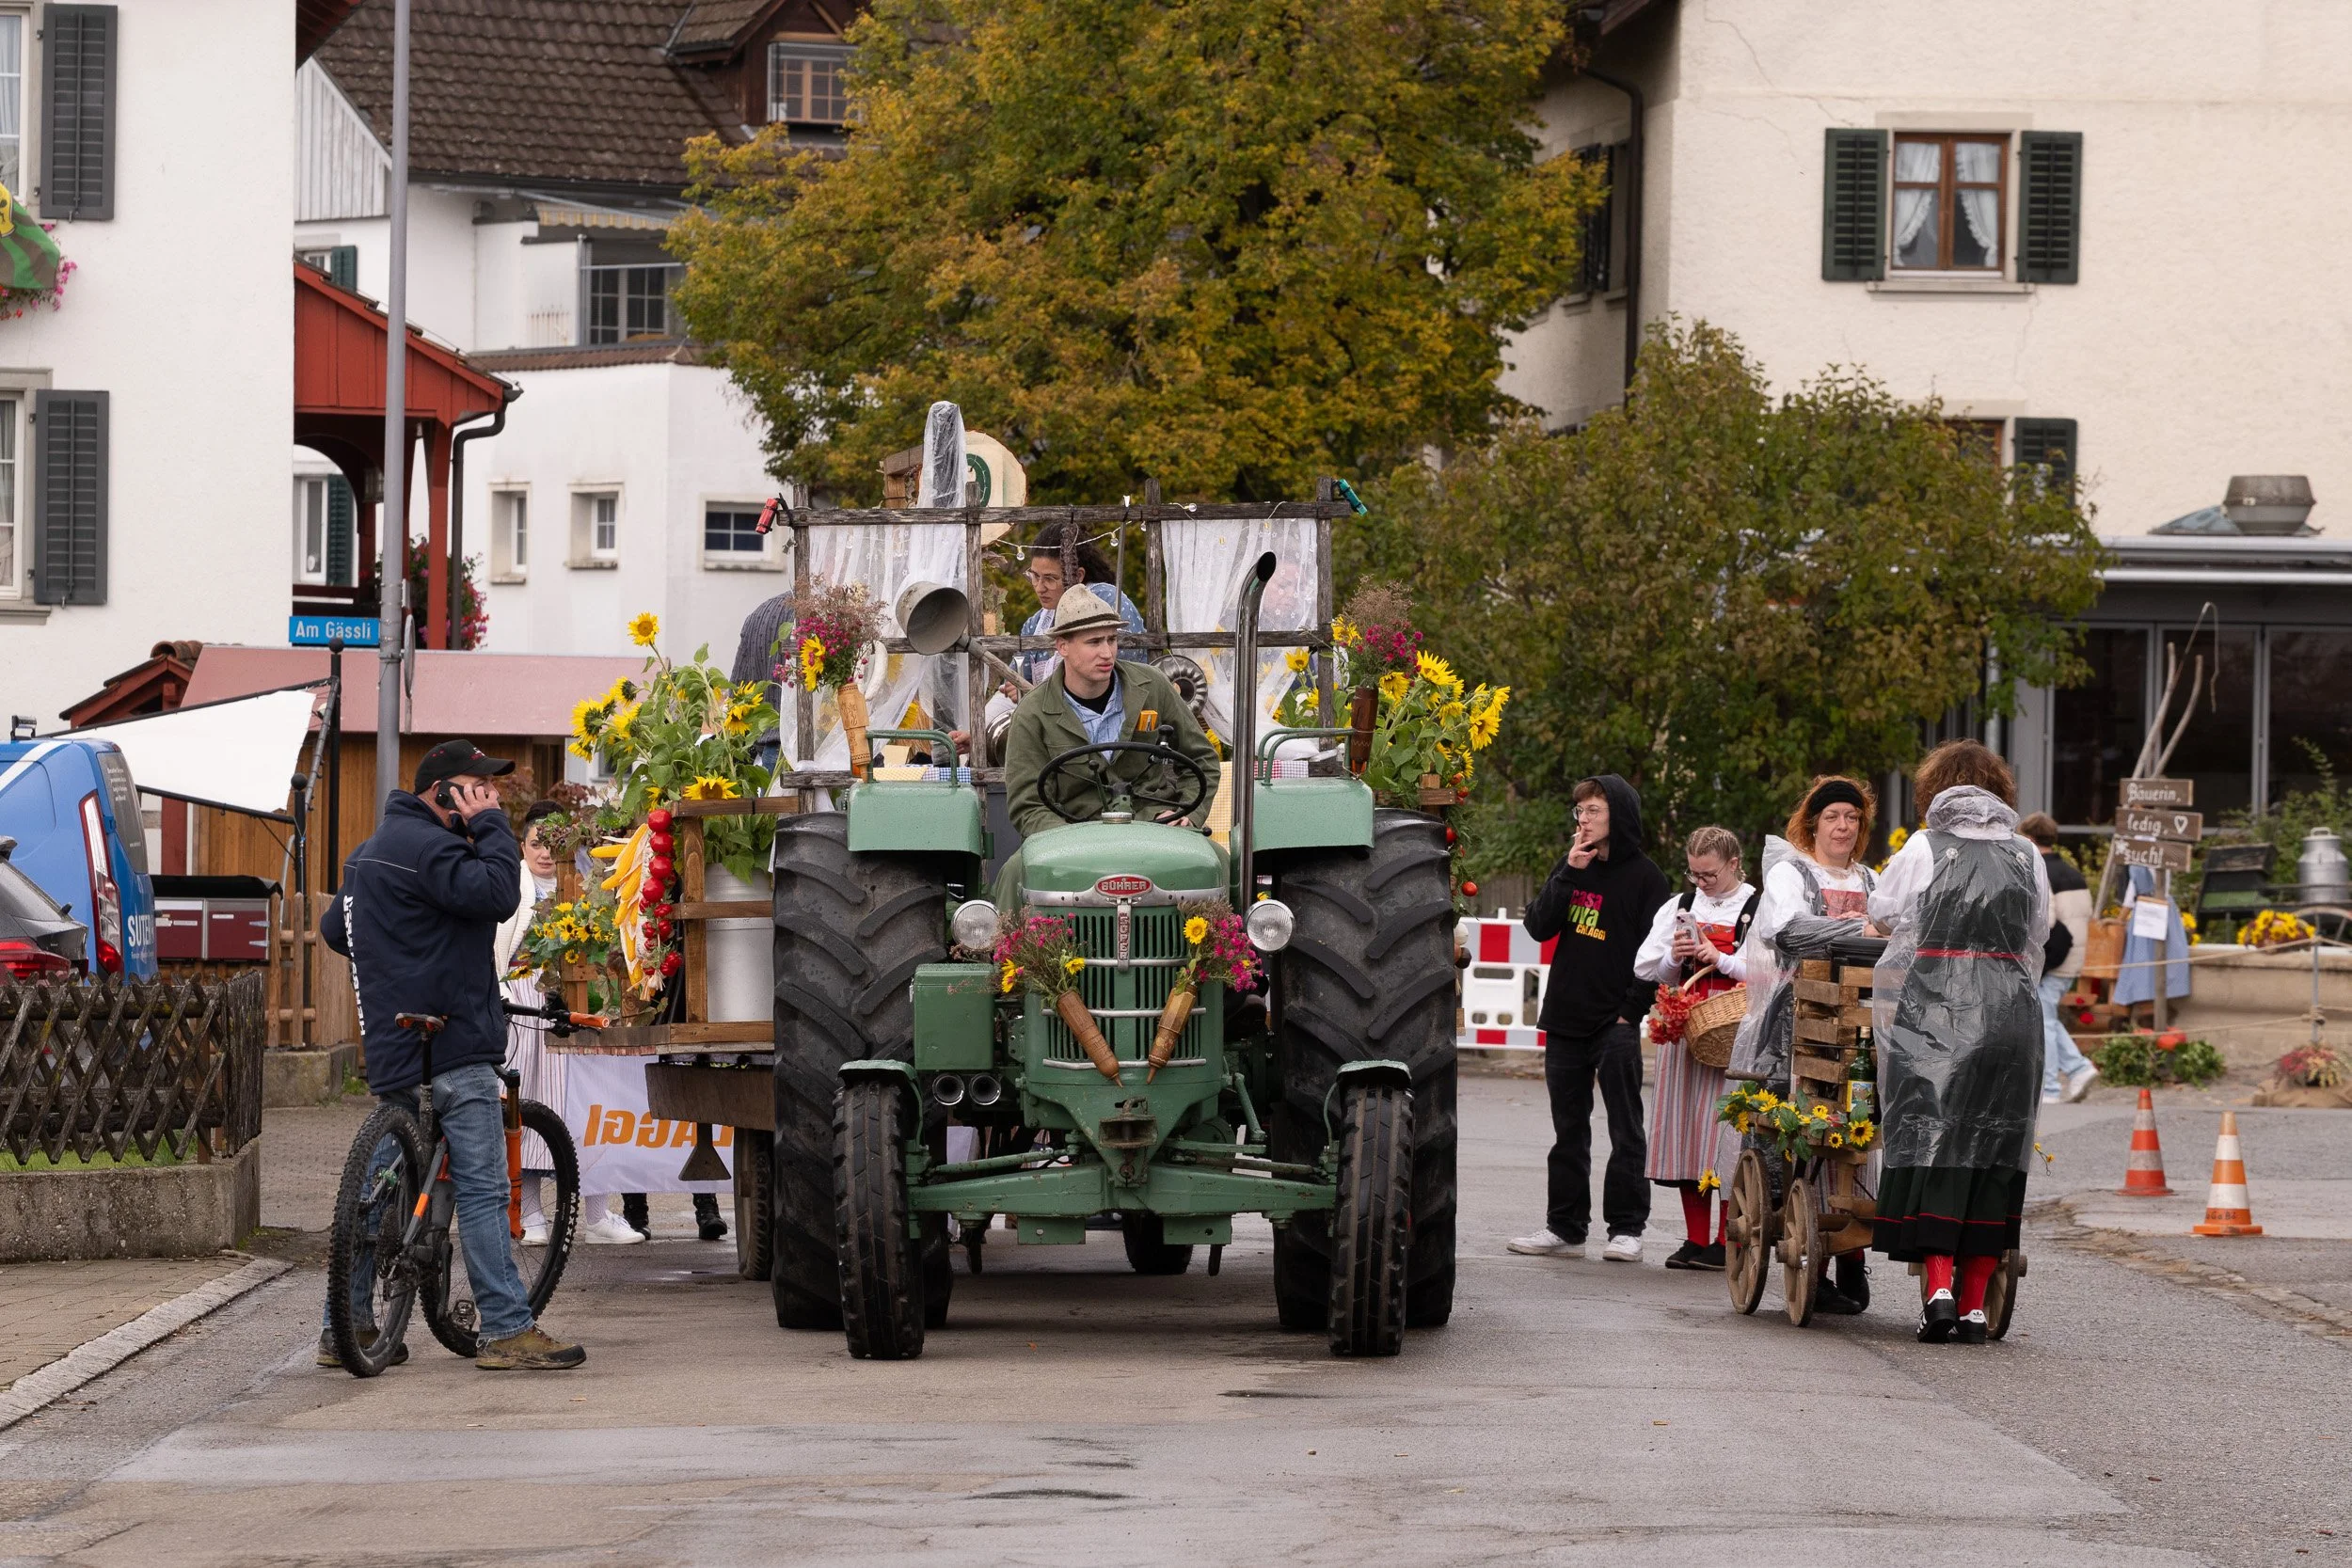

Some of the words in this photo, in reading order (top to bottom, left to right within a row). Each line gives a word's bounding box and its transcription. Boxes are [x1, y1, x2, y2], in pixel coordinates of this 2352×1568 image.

[295, 620, 319, 638] Am
[325, 621, 371, 640] Gässli
[1101, 879, 1147, 891] BÜHRER
[562, 1192, 577, 1254] MAXXIS
